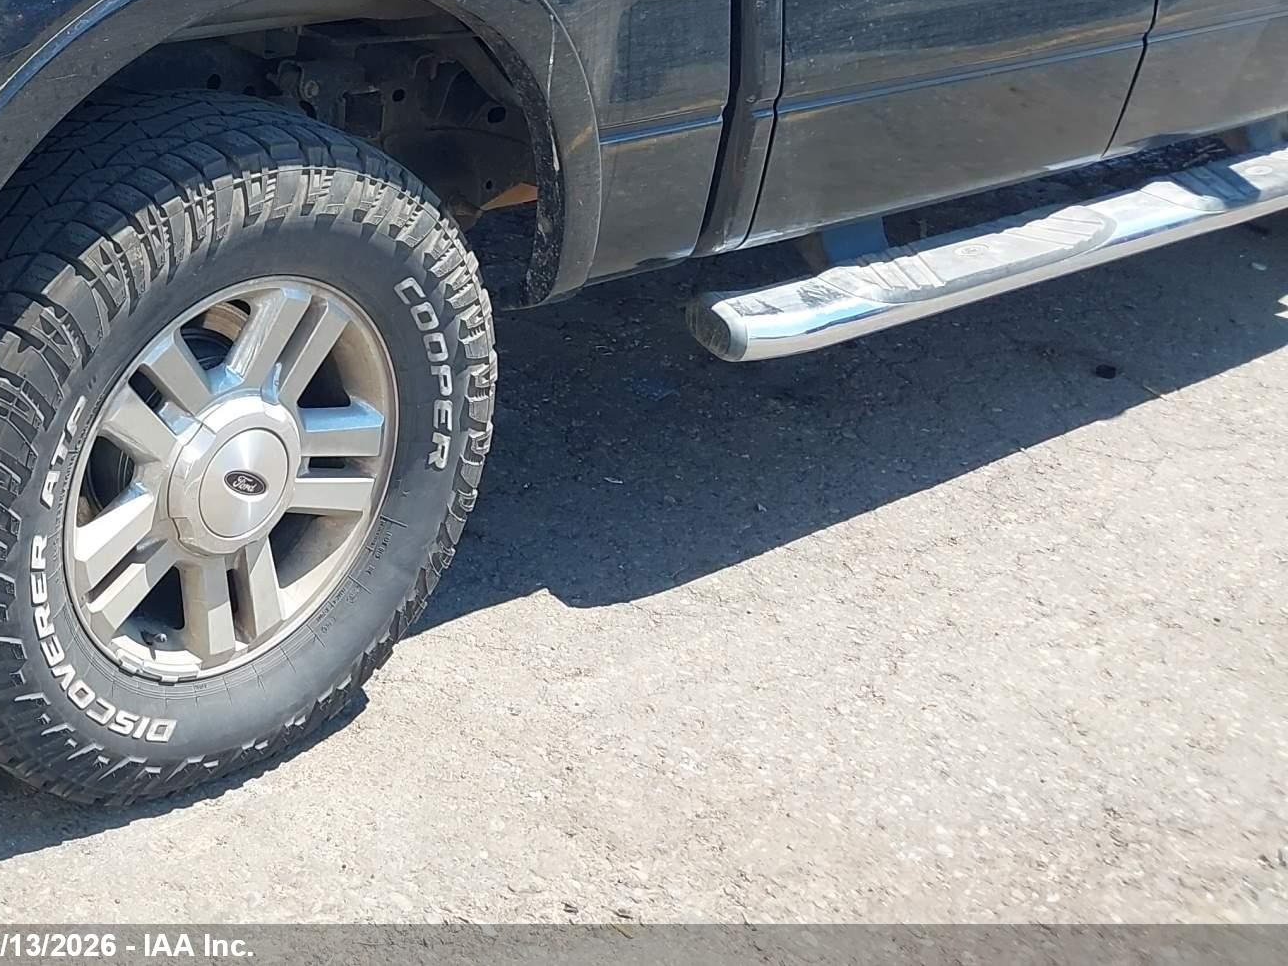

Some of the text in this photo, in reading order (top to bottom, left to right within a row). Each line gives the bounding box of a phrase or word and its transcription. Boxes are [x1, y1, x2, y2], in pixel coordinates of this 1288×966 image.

[393, 276, 454, 472] COOPER
[233, 475, 258, 493] Ford
[30, 534, 178, 743] DISCOVERER
